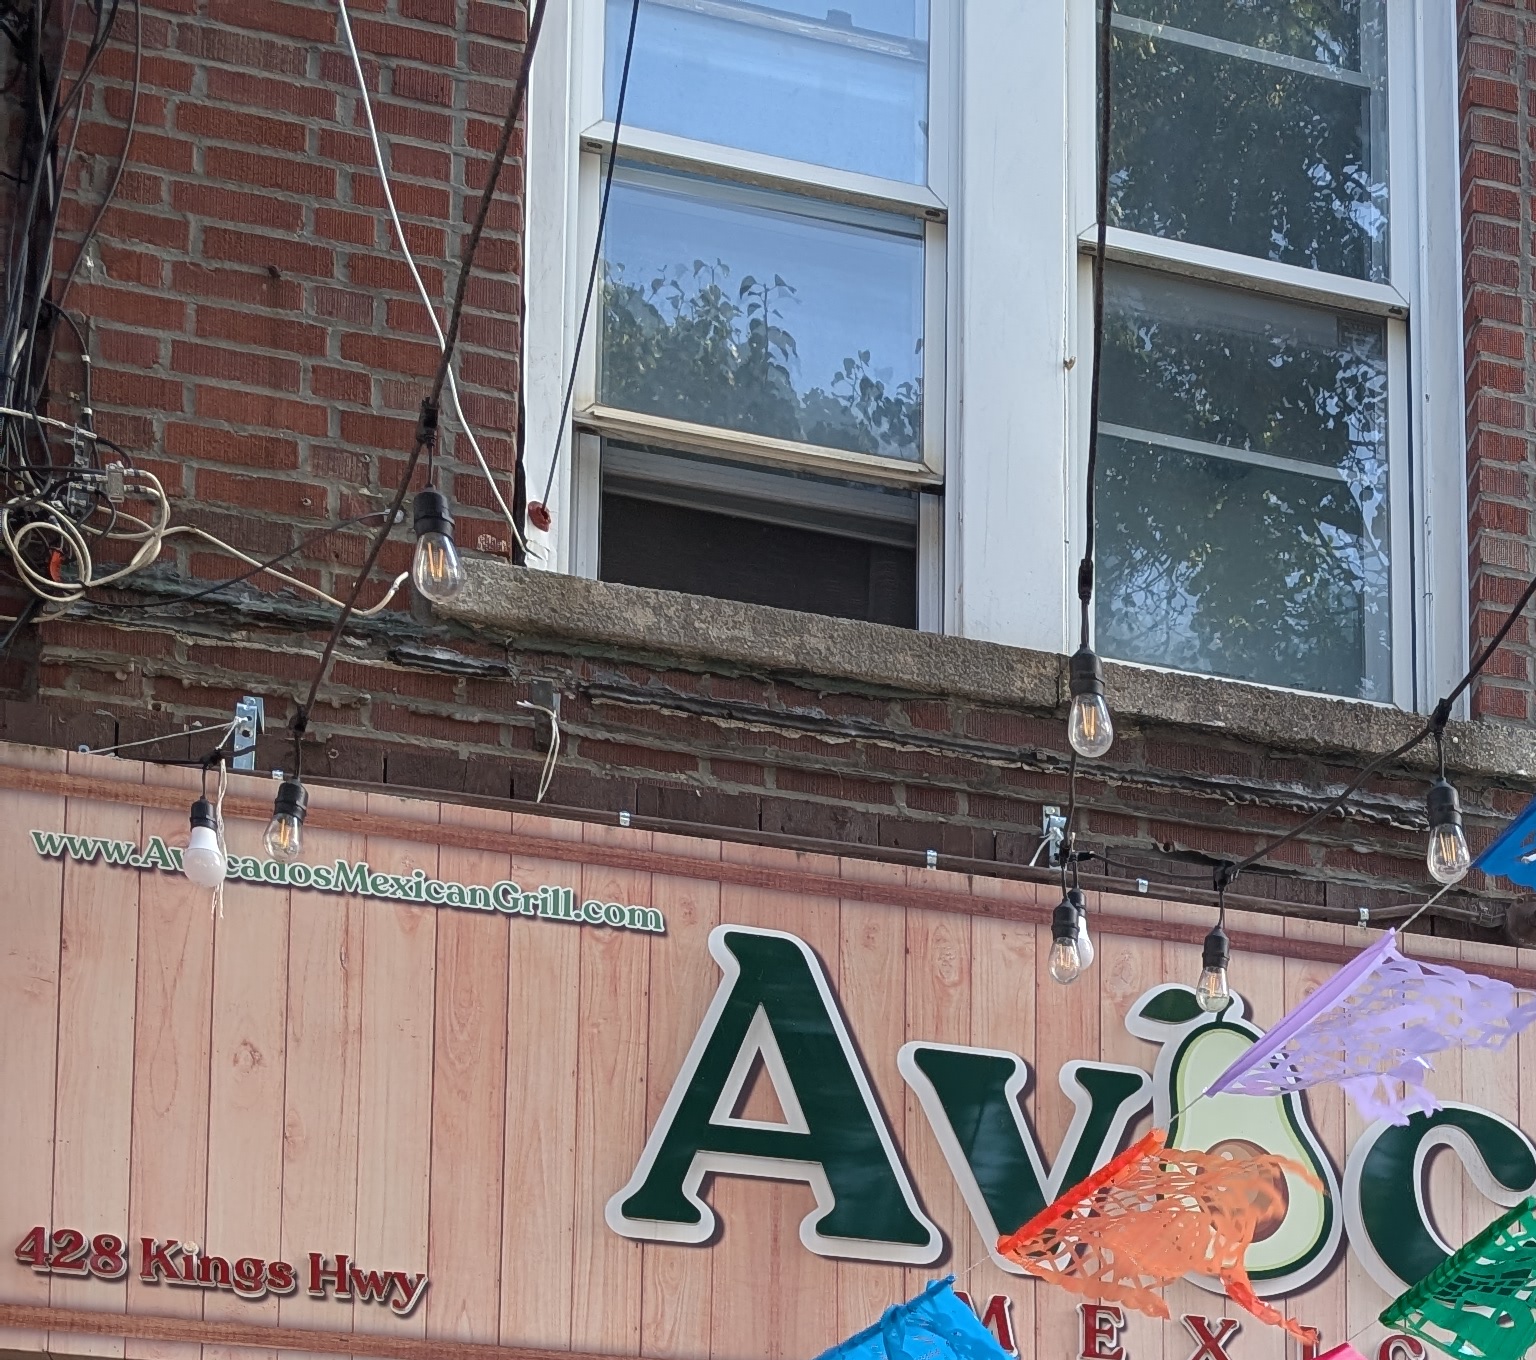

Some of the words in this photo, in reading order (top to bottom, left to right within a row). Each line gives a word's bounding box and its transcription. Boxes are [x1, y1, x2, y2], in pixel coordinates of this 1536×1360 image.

[31, 829, 665, 934] www.AvcadosMexicanGrill.com
[15, 1226, 127, 1280] 428
[140, 1236, 295, 1298] Kings
[307, 1252, 428, 1316] Hwy
